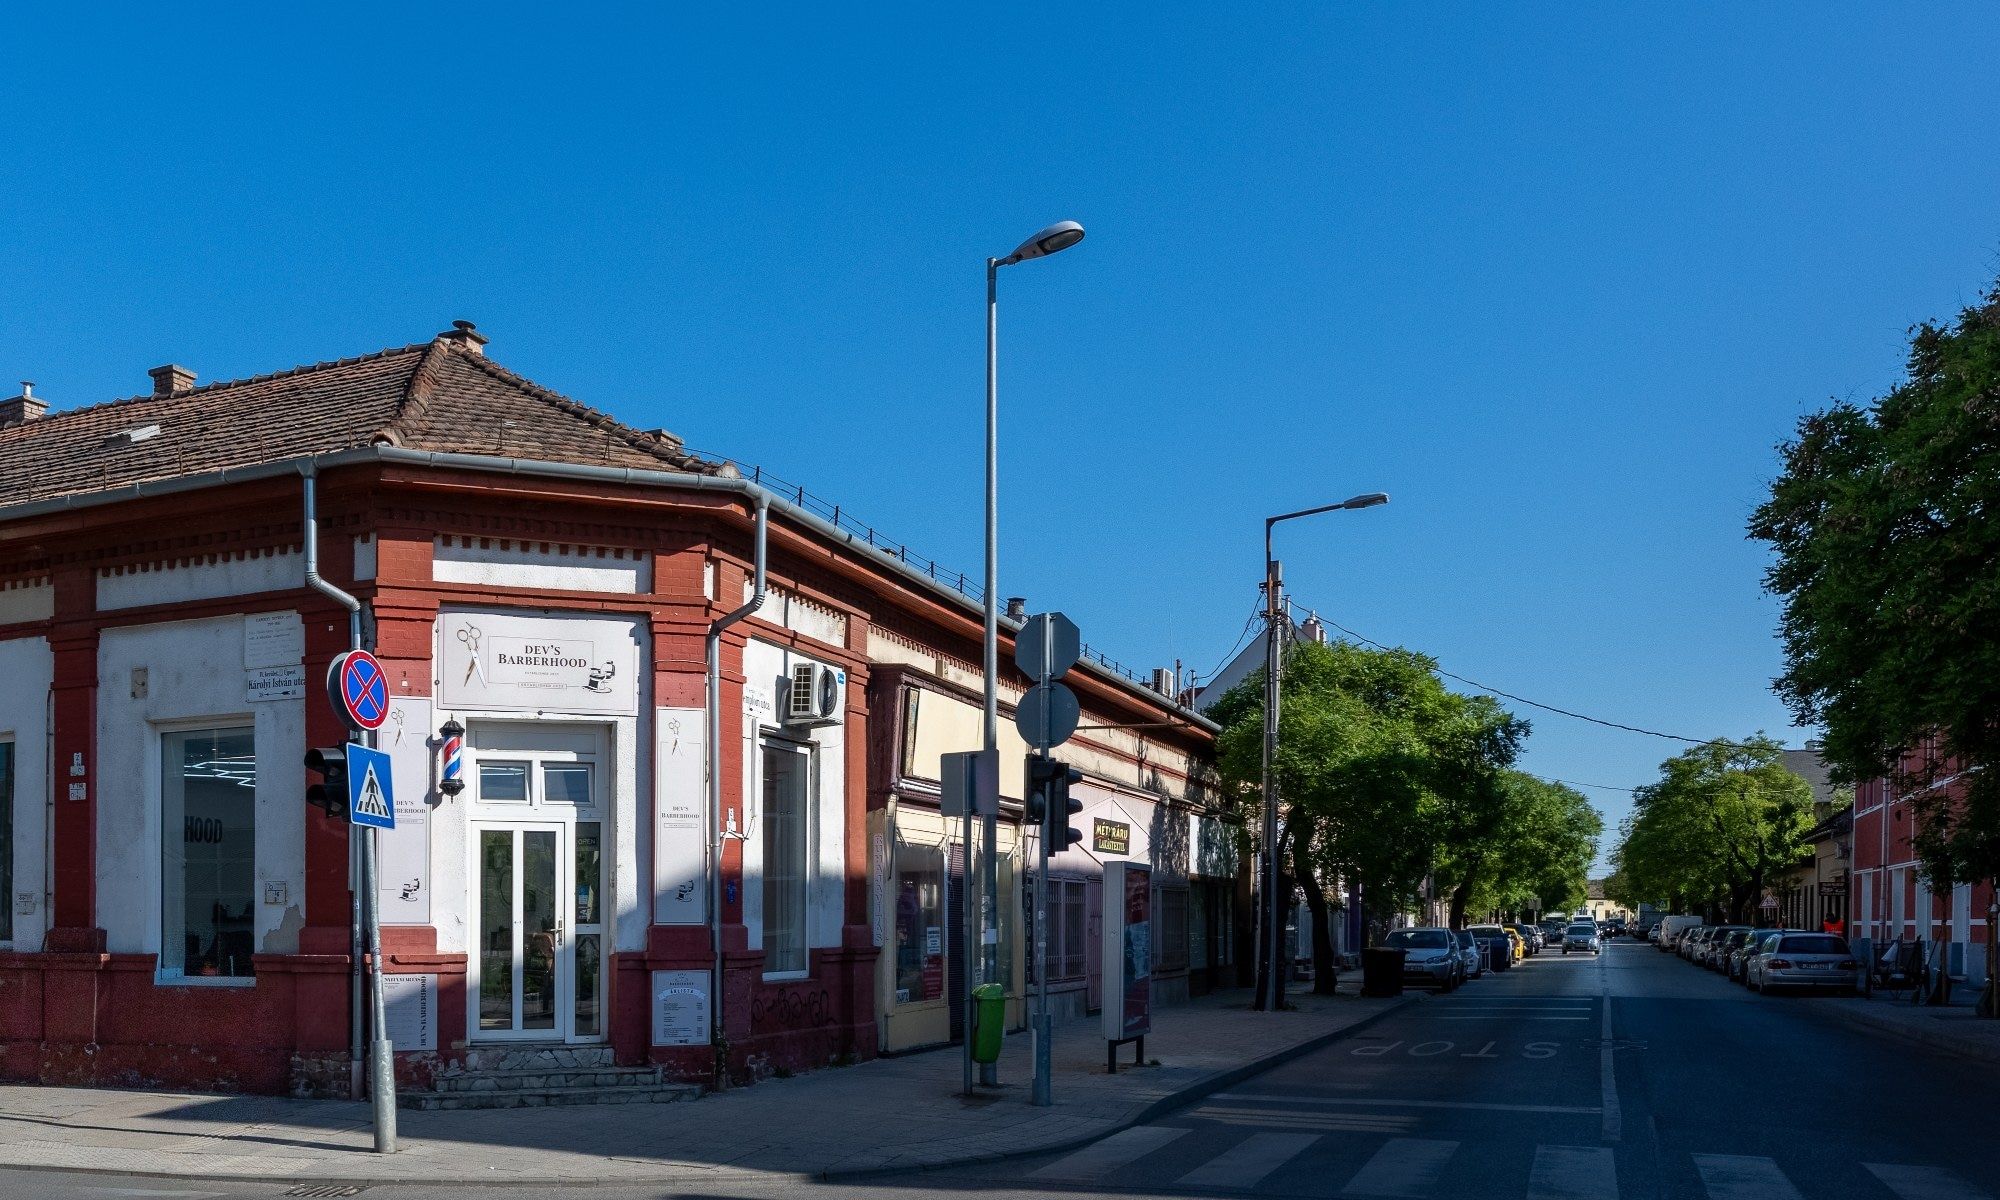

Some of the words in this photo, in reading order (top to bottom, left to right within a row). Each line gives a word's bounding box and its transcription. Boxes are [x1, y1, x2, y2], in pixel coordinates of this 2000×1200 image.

[525, 645, 561, 655] DEV'S
[498, 654, 587, 668] BARBERHOOD
[248, 679, 271, 690] Károlyi
[272, 677, 292, 688] István
[1350, 1040, 1561, 1059] STOP
